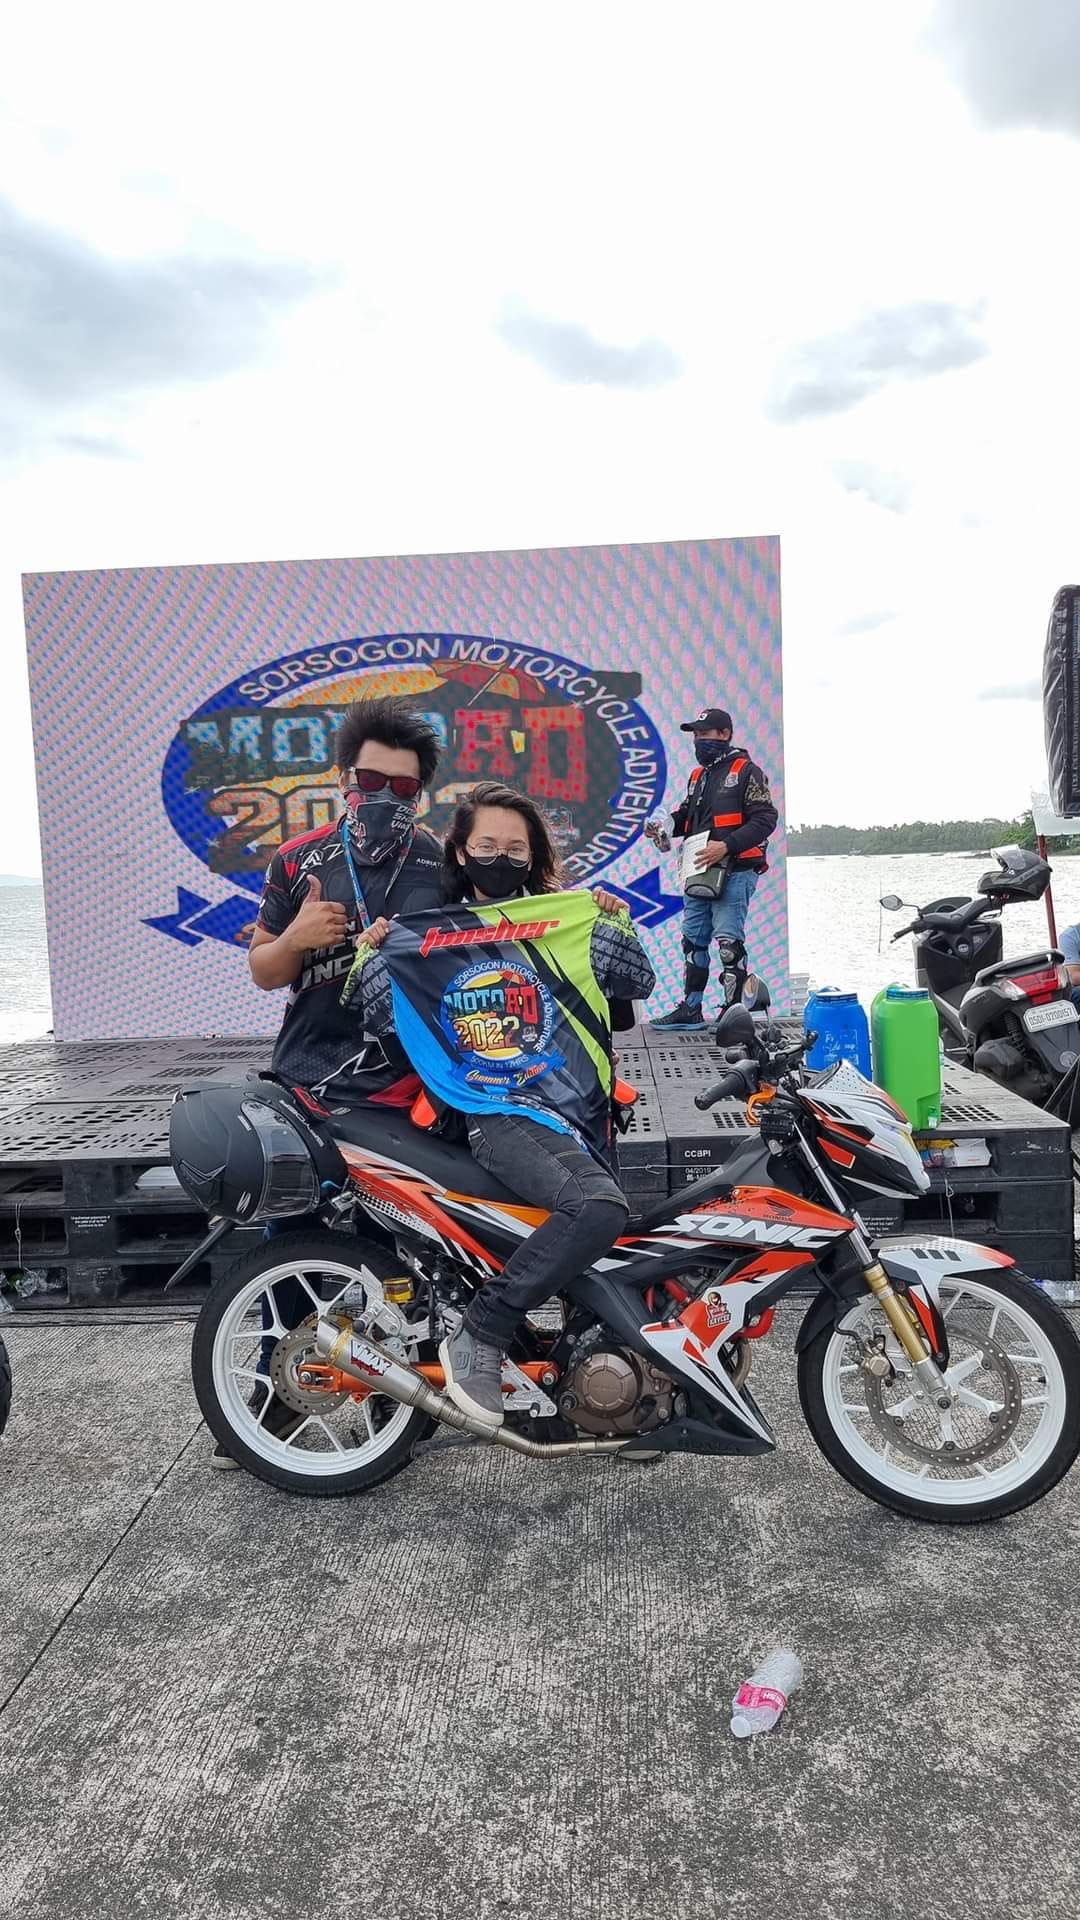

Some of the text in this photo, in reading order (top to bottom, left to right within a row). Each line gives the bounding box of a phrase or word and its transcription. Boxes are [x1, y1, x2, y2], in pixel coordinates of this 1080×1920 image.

[238, 638, 440, 702] SORSOGON
[449, 639, 649, 746] MOTORCYCLE
[561, 747, 655, 878] ADVENTURE
[454, 961, 553, 1053] SORSOGON MOTORCYCLE ADVENTURE
[453, 1015, 520, 1052] 2022
[684, 1149, 712, 1158] CCBPI
[651, 1213, 847, 1249] SONIC
[762, 1213, 793, 1222] HONDA
